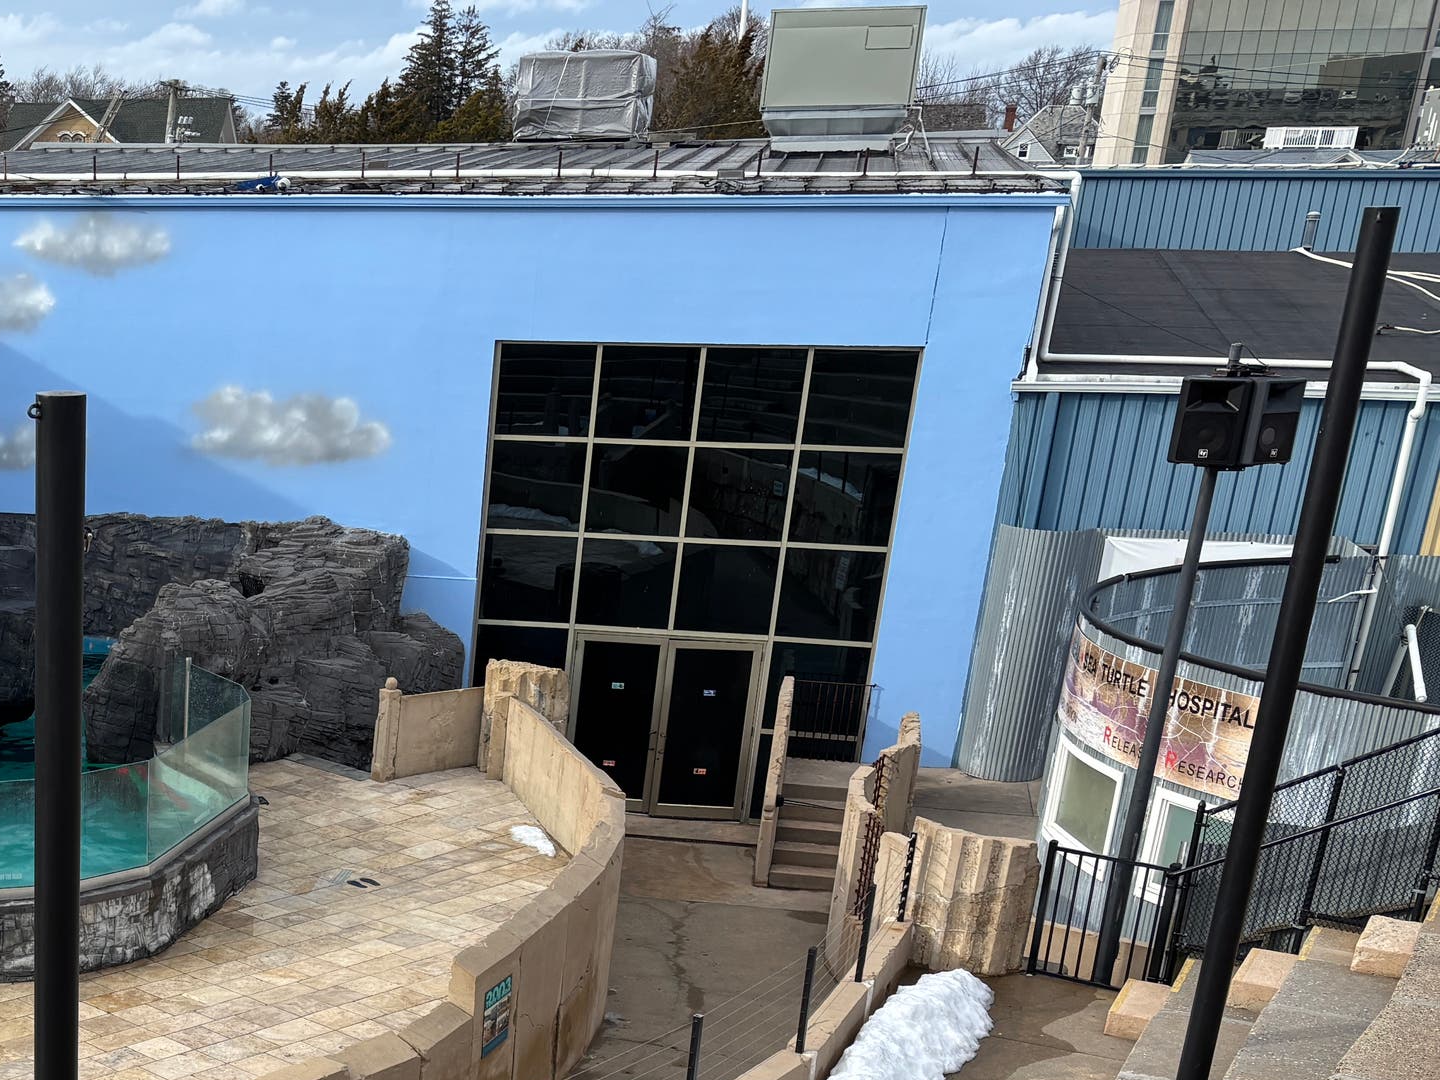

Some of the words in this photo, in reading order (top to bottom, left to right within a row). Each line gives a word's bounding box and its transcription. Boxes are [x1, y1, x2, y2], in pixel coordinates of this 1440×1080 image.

[1102, 663, 1149, 698] TURTLE
[1169, 689, 1254, 730] HOSPITAL
[1104, 725, 1144, 759] RELEAS
[486, 976, 512, 1009] 2003
